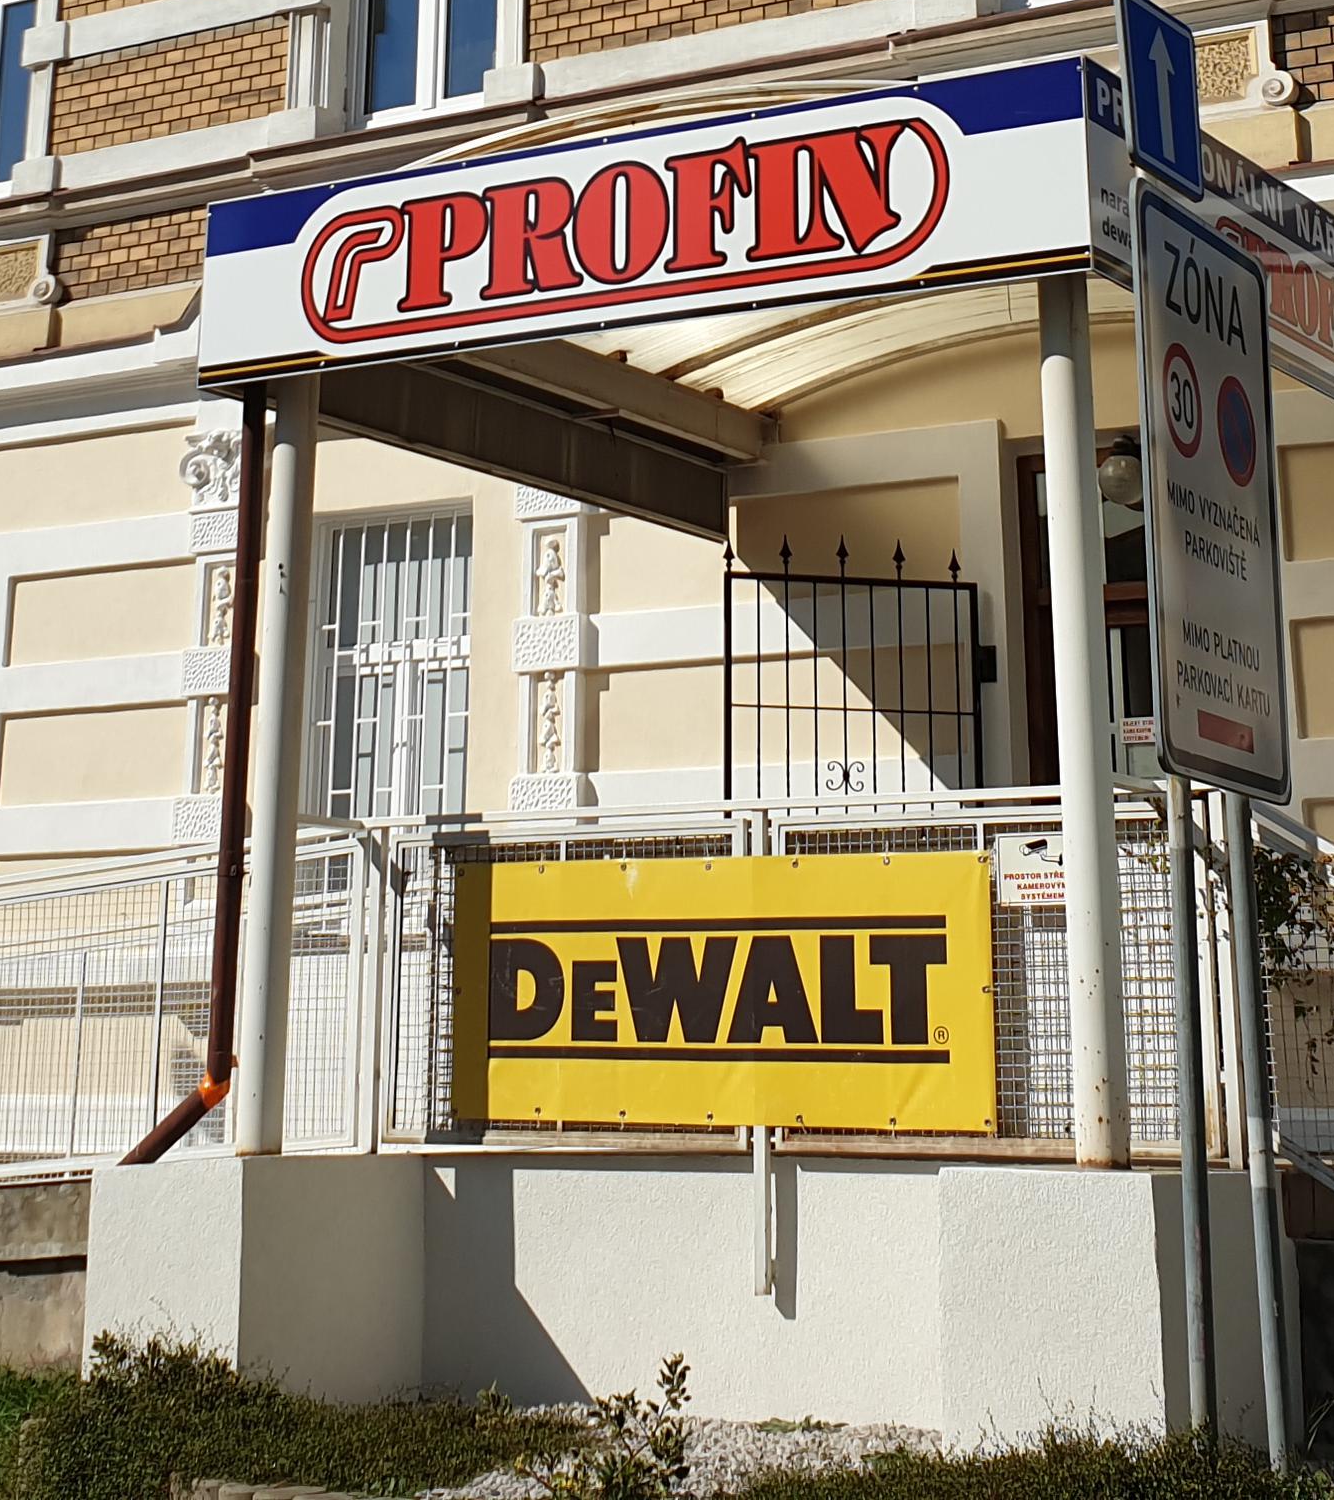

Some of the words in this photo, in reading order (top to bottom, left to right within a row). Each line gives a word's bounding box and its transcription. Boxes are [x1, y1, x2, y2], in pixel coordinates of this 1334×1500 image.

[1095, 77, 1124, 127] PR
[1200, 142, 1284, 228] ONÁLNÍ
[398, 119, 905, 312] PROFIN
[1100, 187, 1129, 217] nara
[1163, 238, 1247, 355] ZÓNA
[1170, 371, 1194, 429] 30
[1167, 480, 1195, 514] MIMO
[1198, 495, 1261, 548] VYZNAČENÁ
[1185, 530, 1248, 582] PARKOVIŠTĚ
[1182, 620, 1210, 652] MIMO
[1213, 631, 1260, 672] PLATNOU
[1176, 660, 1234, 704] PARKOVACÍ
[1237, 683, 1271, 717] KARTU
[1003, 872, 1042, 881] PROSTOR
[1044, 870, 1065, 880] STŘE
